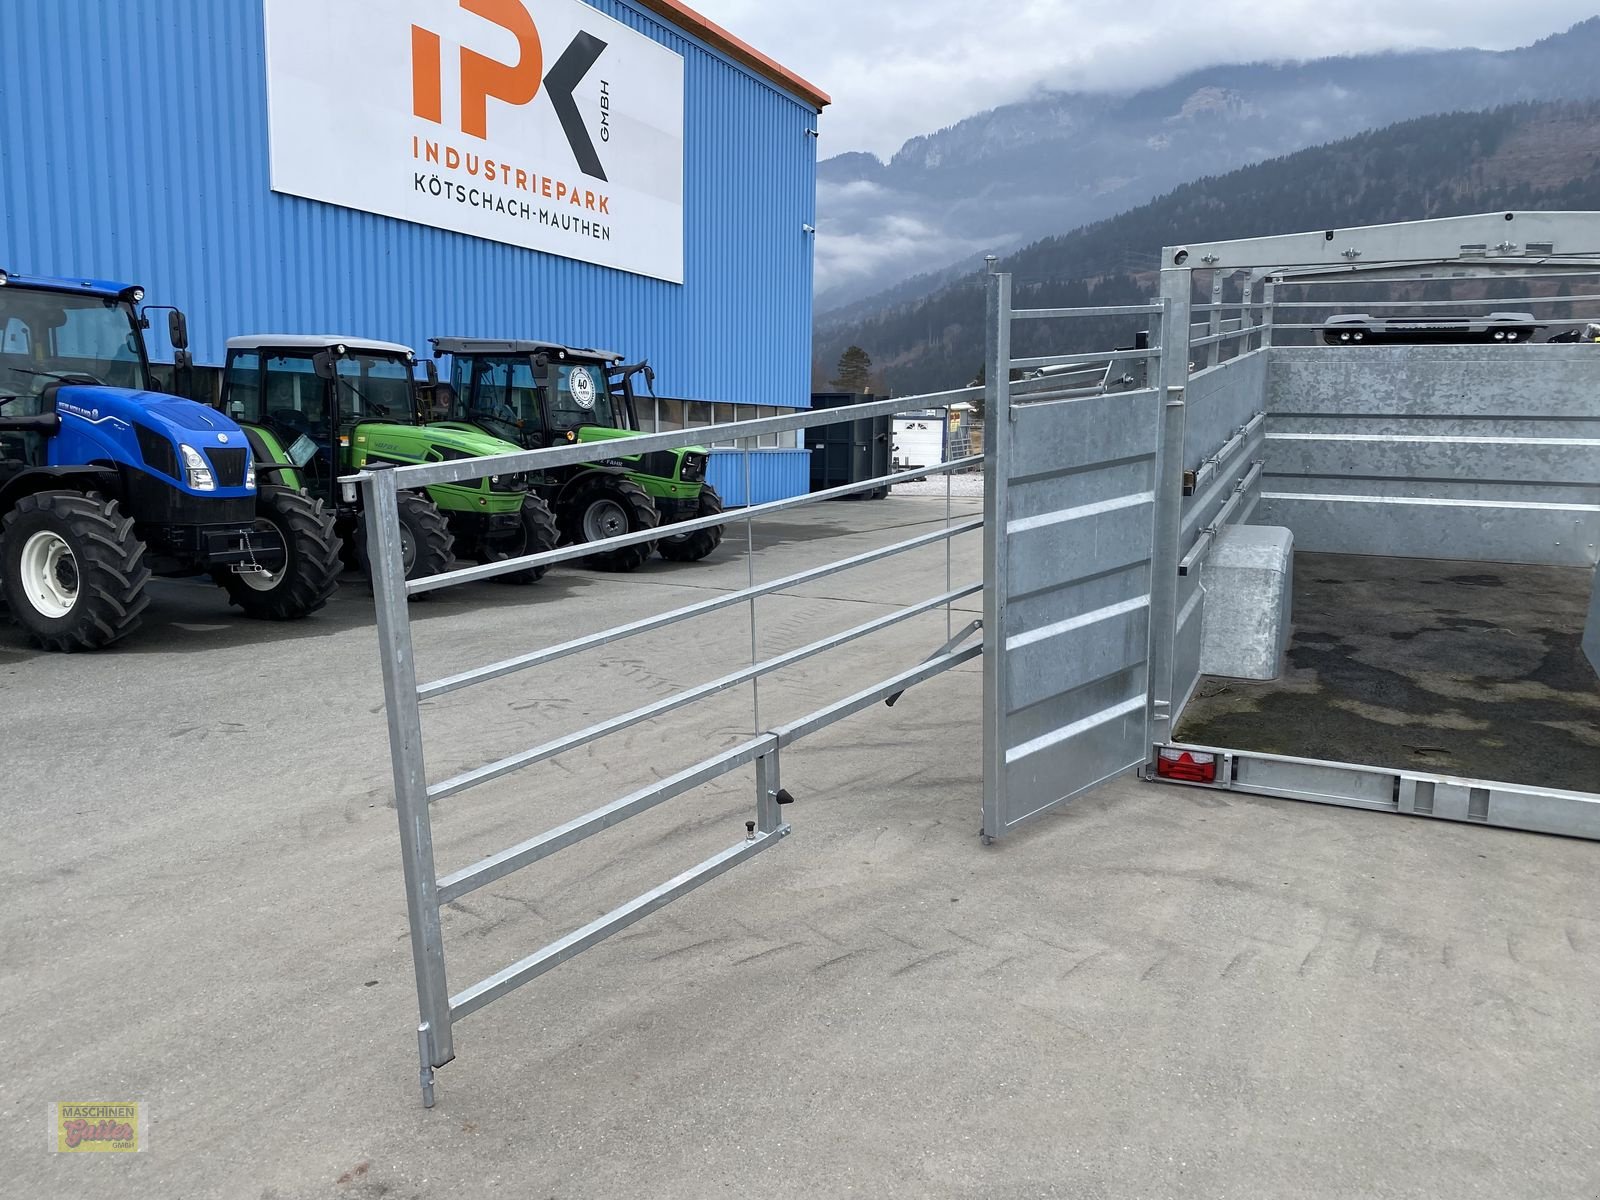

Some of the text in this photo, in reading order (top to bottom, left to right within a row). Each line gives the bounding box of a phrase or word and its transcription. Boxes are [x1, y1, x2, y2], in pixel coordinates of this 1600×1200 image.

[600, 79, 610, 142] GMBH
[413, 136, 610, 215] INDUSTRIEPARK
[414, 172, 611, 241] KÖTSCHACH-MAUTHEN
[577, 379, 588, 390] 40
